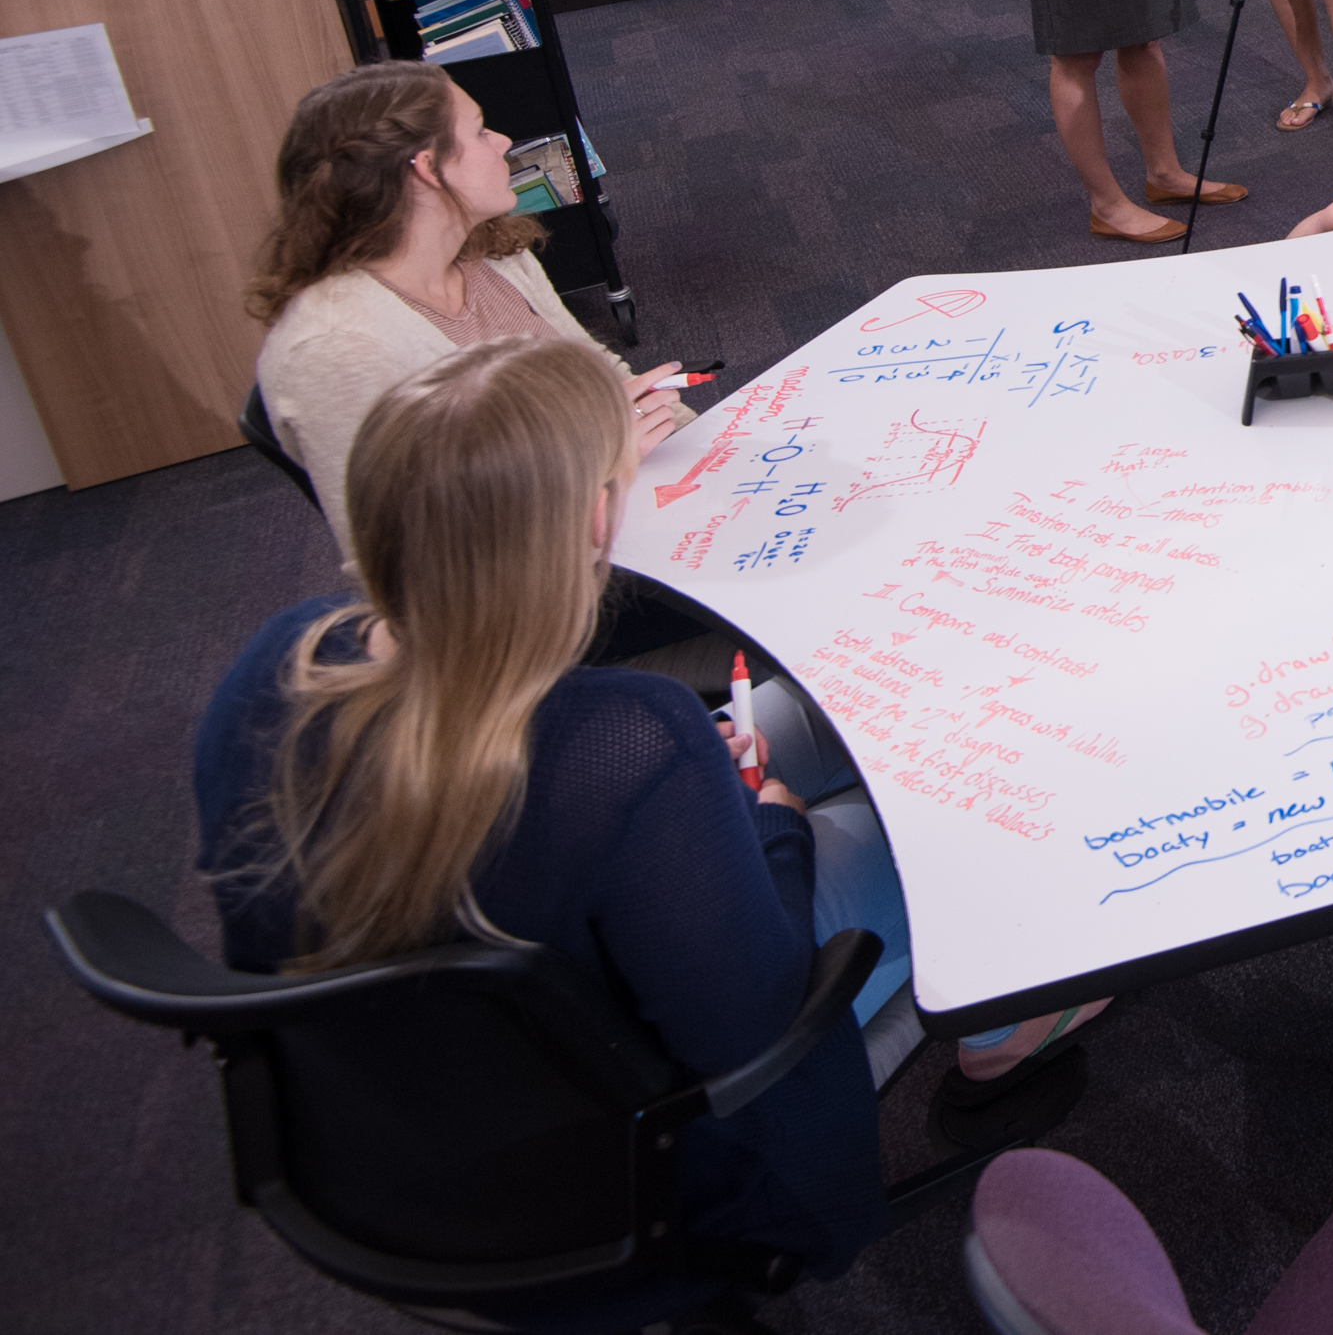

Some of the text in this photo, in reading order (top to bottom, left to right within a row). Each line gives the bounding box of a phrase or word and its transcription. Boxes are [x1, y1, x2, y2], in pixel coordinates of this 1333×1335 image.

[1085, 785, 1266, 851] boatmobile
[1113, 828, 1210, 868] boaty
[1267, 794, 1327, 826] new
